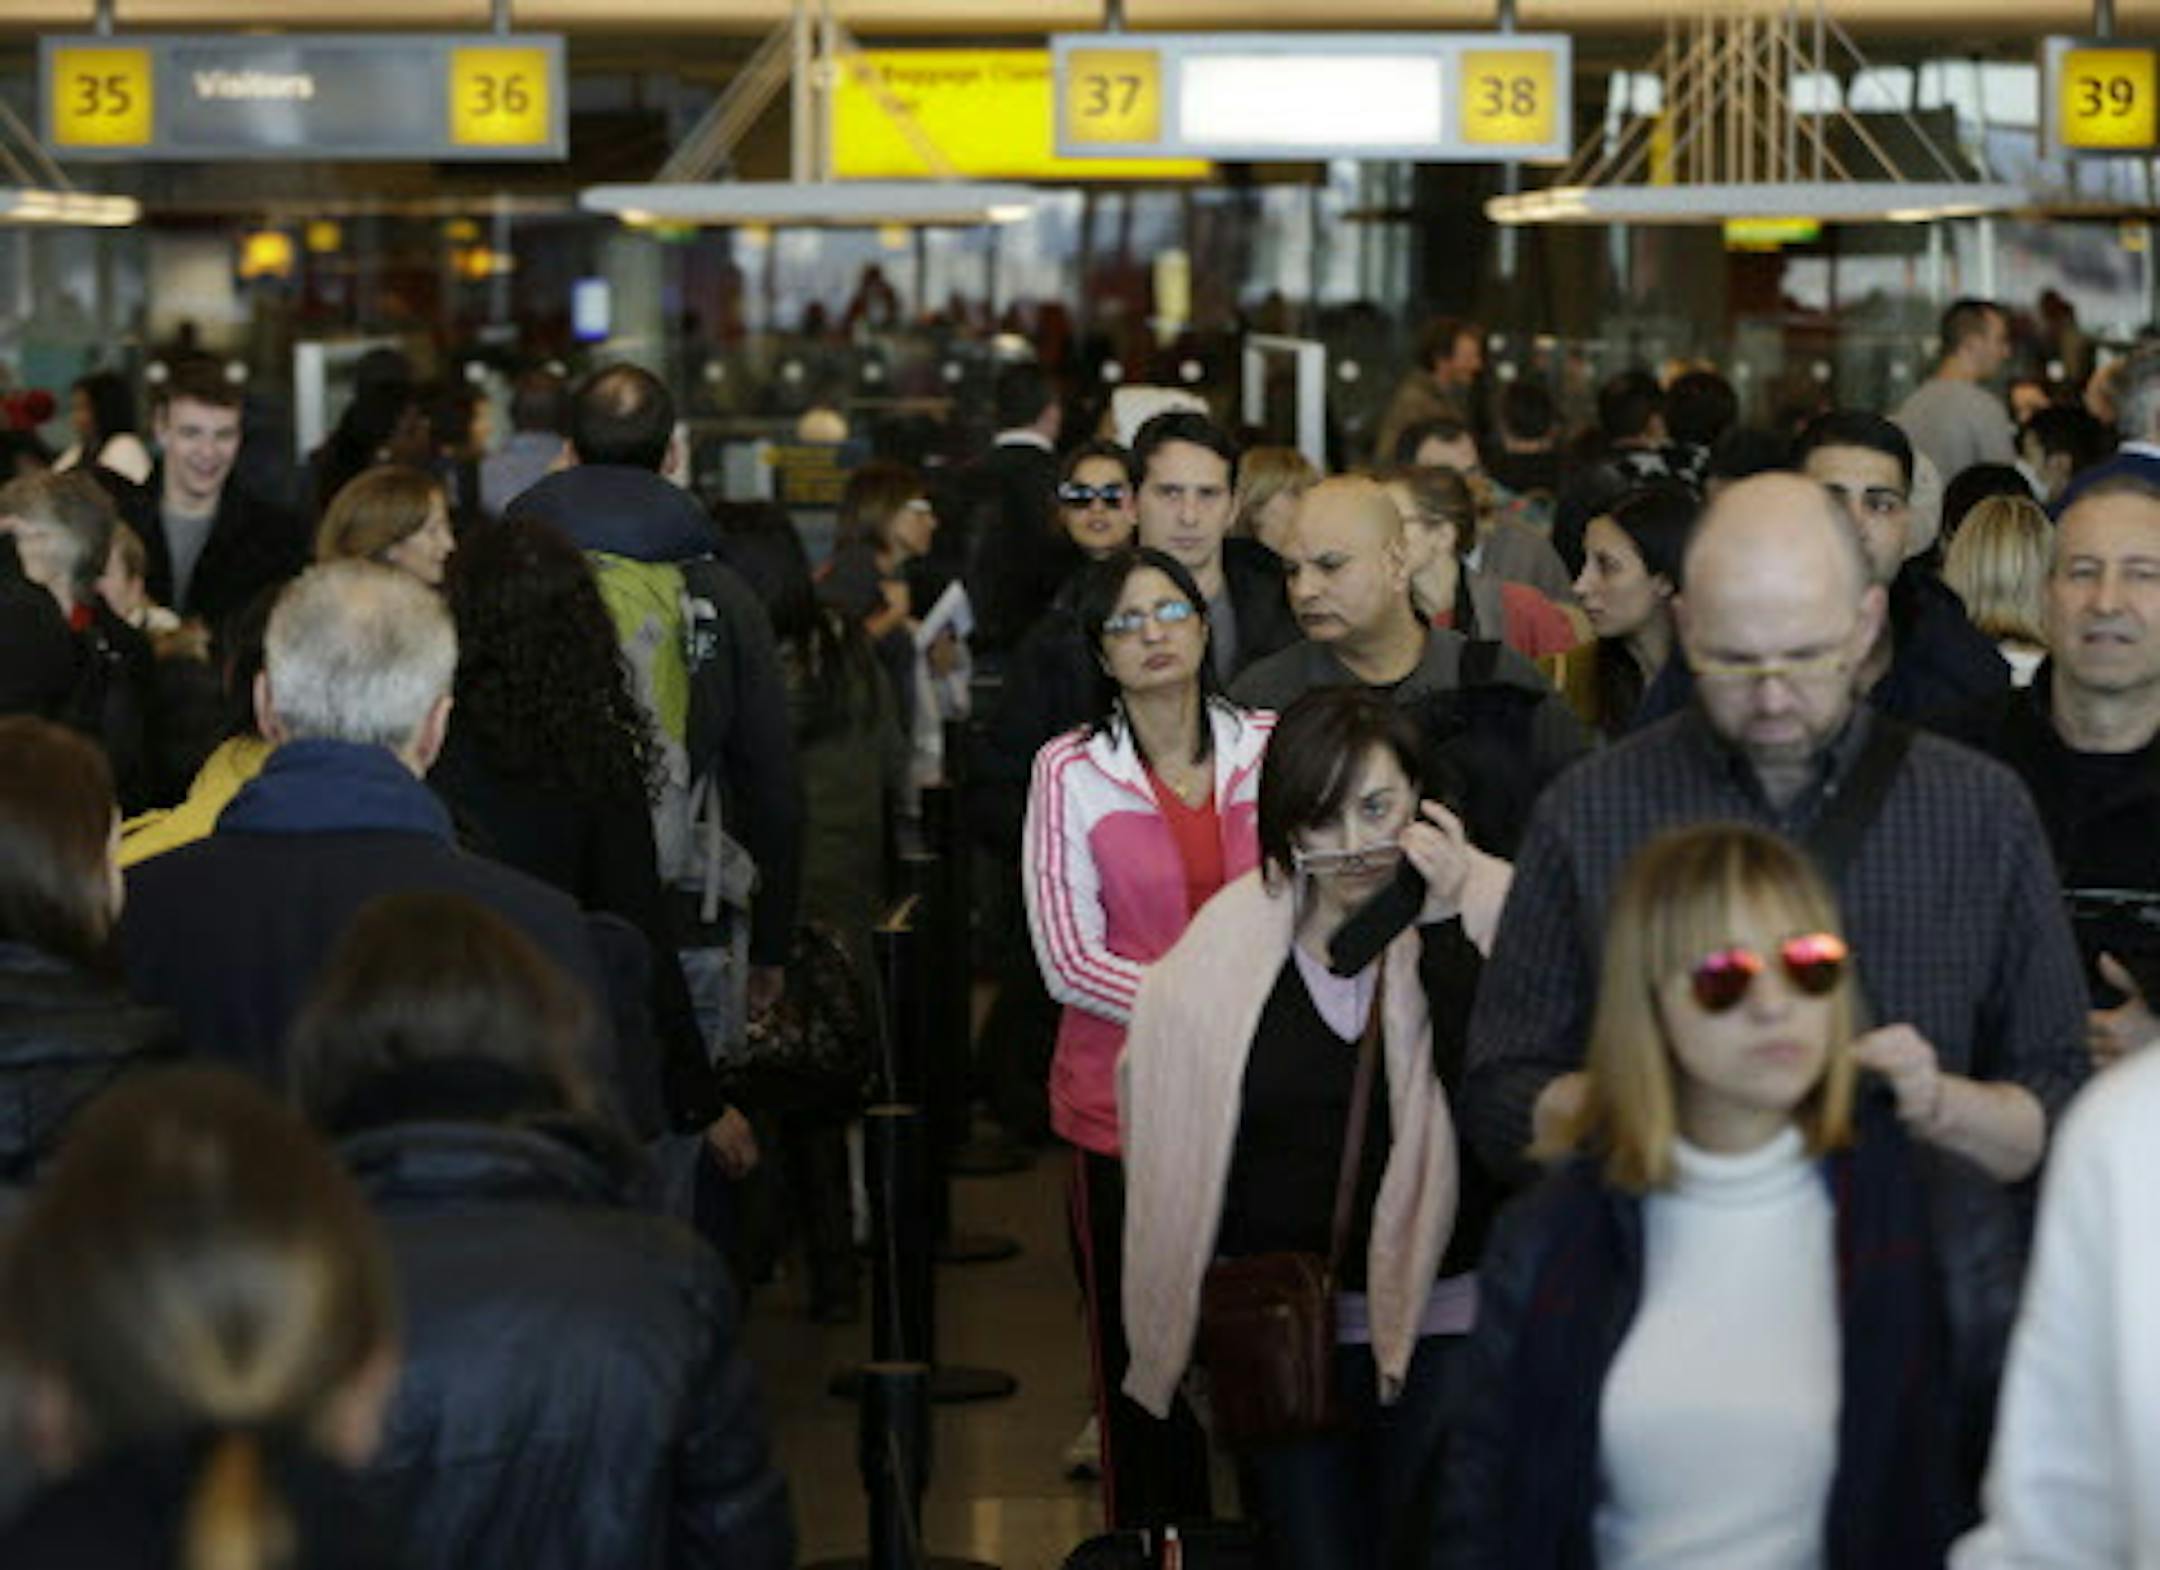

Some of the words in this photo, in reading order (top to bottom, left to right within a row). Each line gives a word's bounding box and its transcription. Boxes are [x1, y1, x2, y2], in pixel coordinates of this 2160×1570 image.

[73, 75, 133, 117] 35
[470, 75, 531, 117] 36
[1083, 76, 1143, 116] 37
[1477, 77, 1537, 118] 38
[2077, 76, 2135, 118] 39
